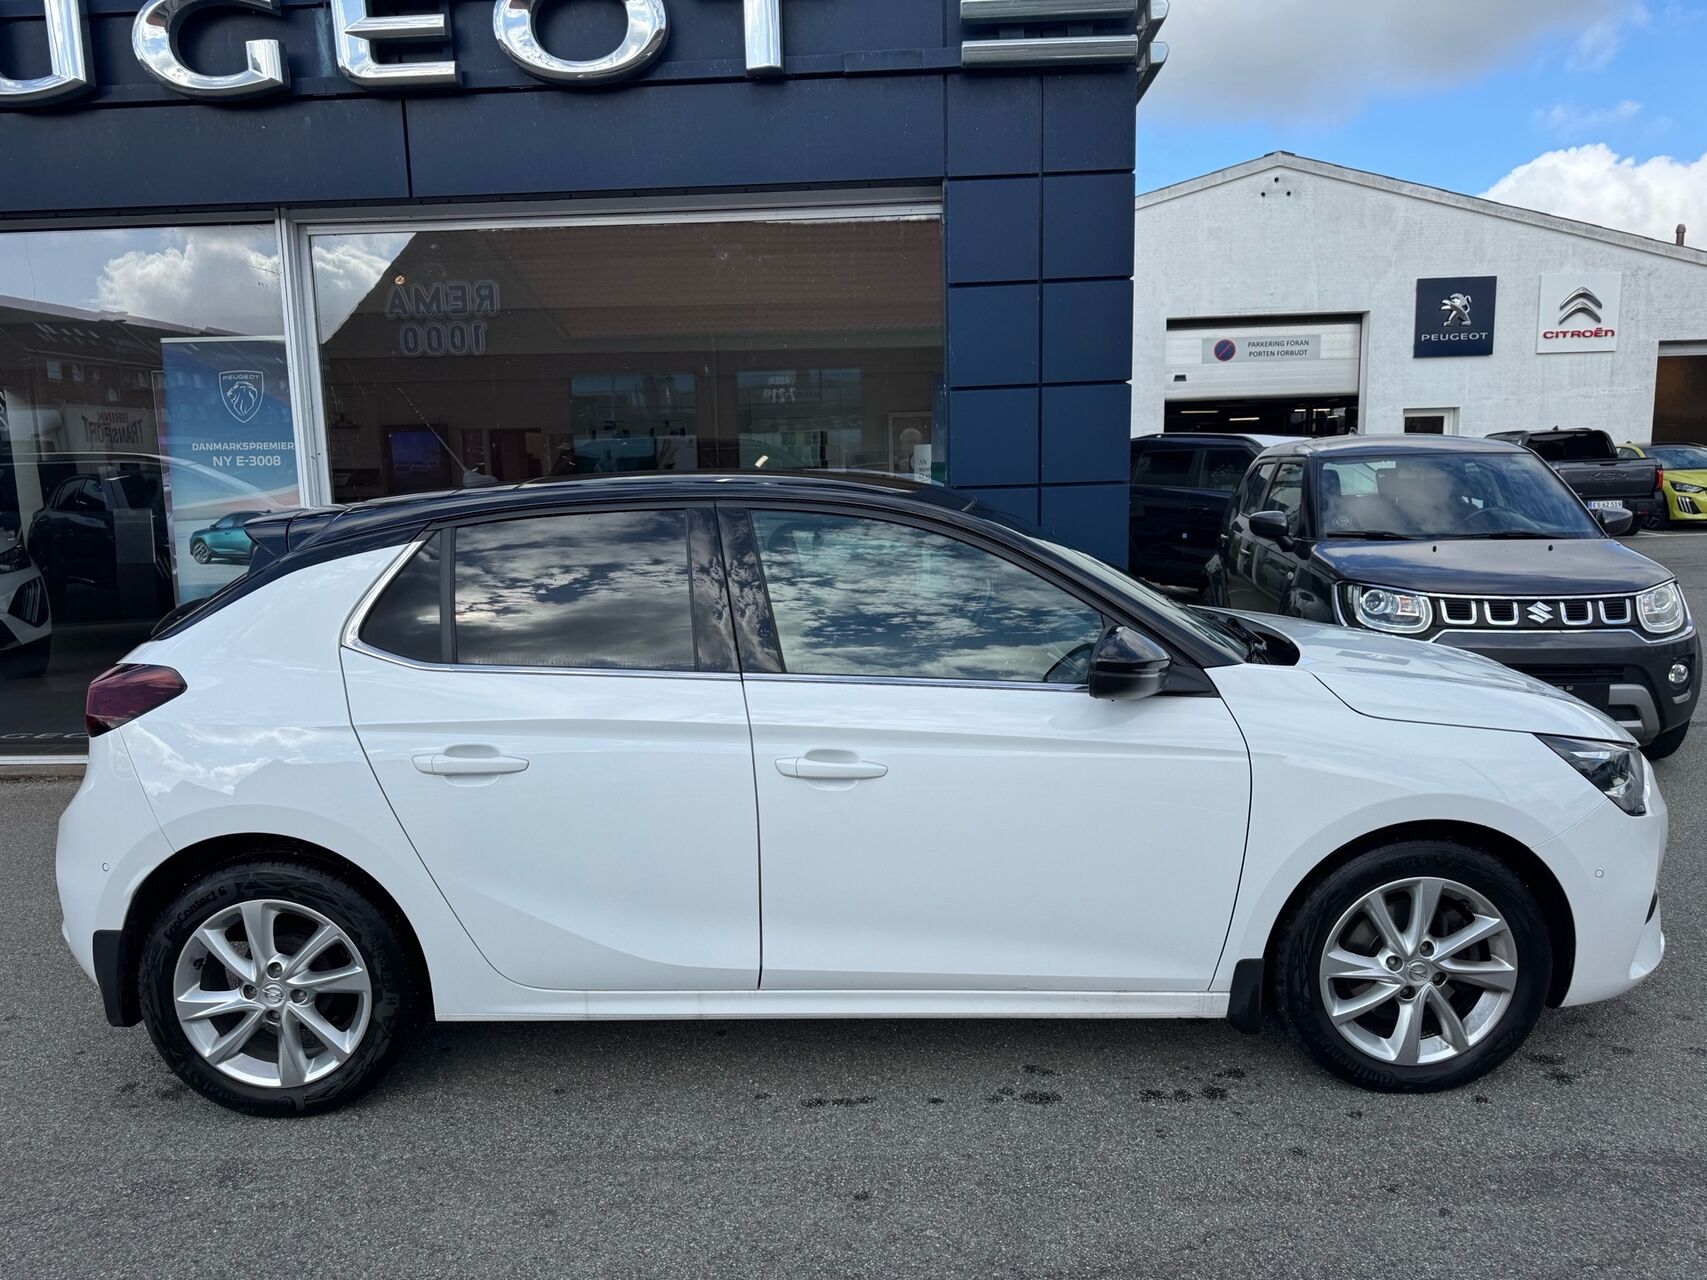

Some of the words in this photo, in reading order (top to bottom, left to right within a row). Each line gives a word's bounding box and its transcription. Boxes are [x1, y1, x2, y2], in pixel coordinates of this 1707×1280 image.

[1421, 332, 1488, 341] PEUGEOT
[1247, 340, 1285, 348] PARKERING
[192, 442, 295, 451] DANMARKSPREMIER
[212, 456, 233, 467] NY
[236, 455, 281, 466] E-3008
